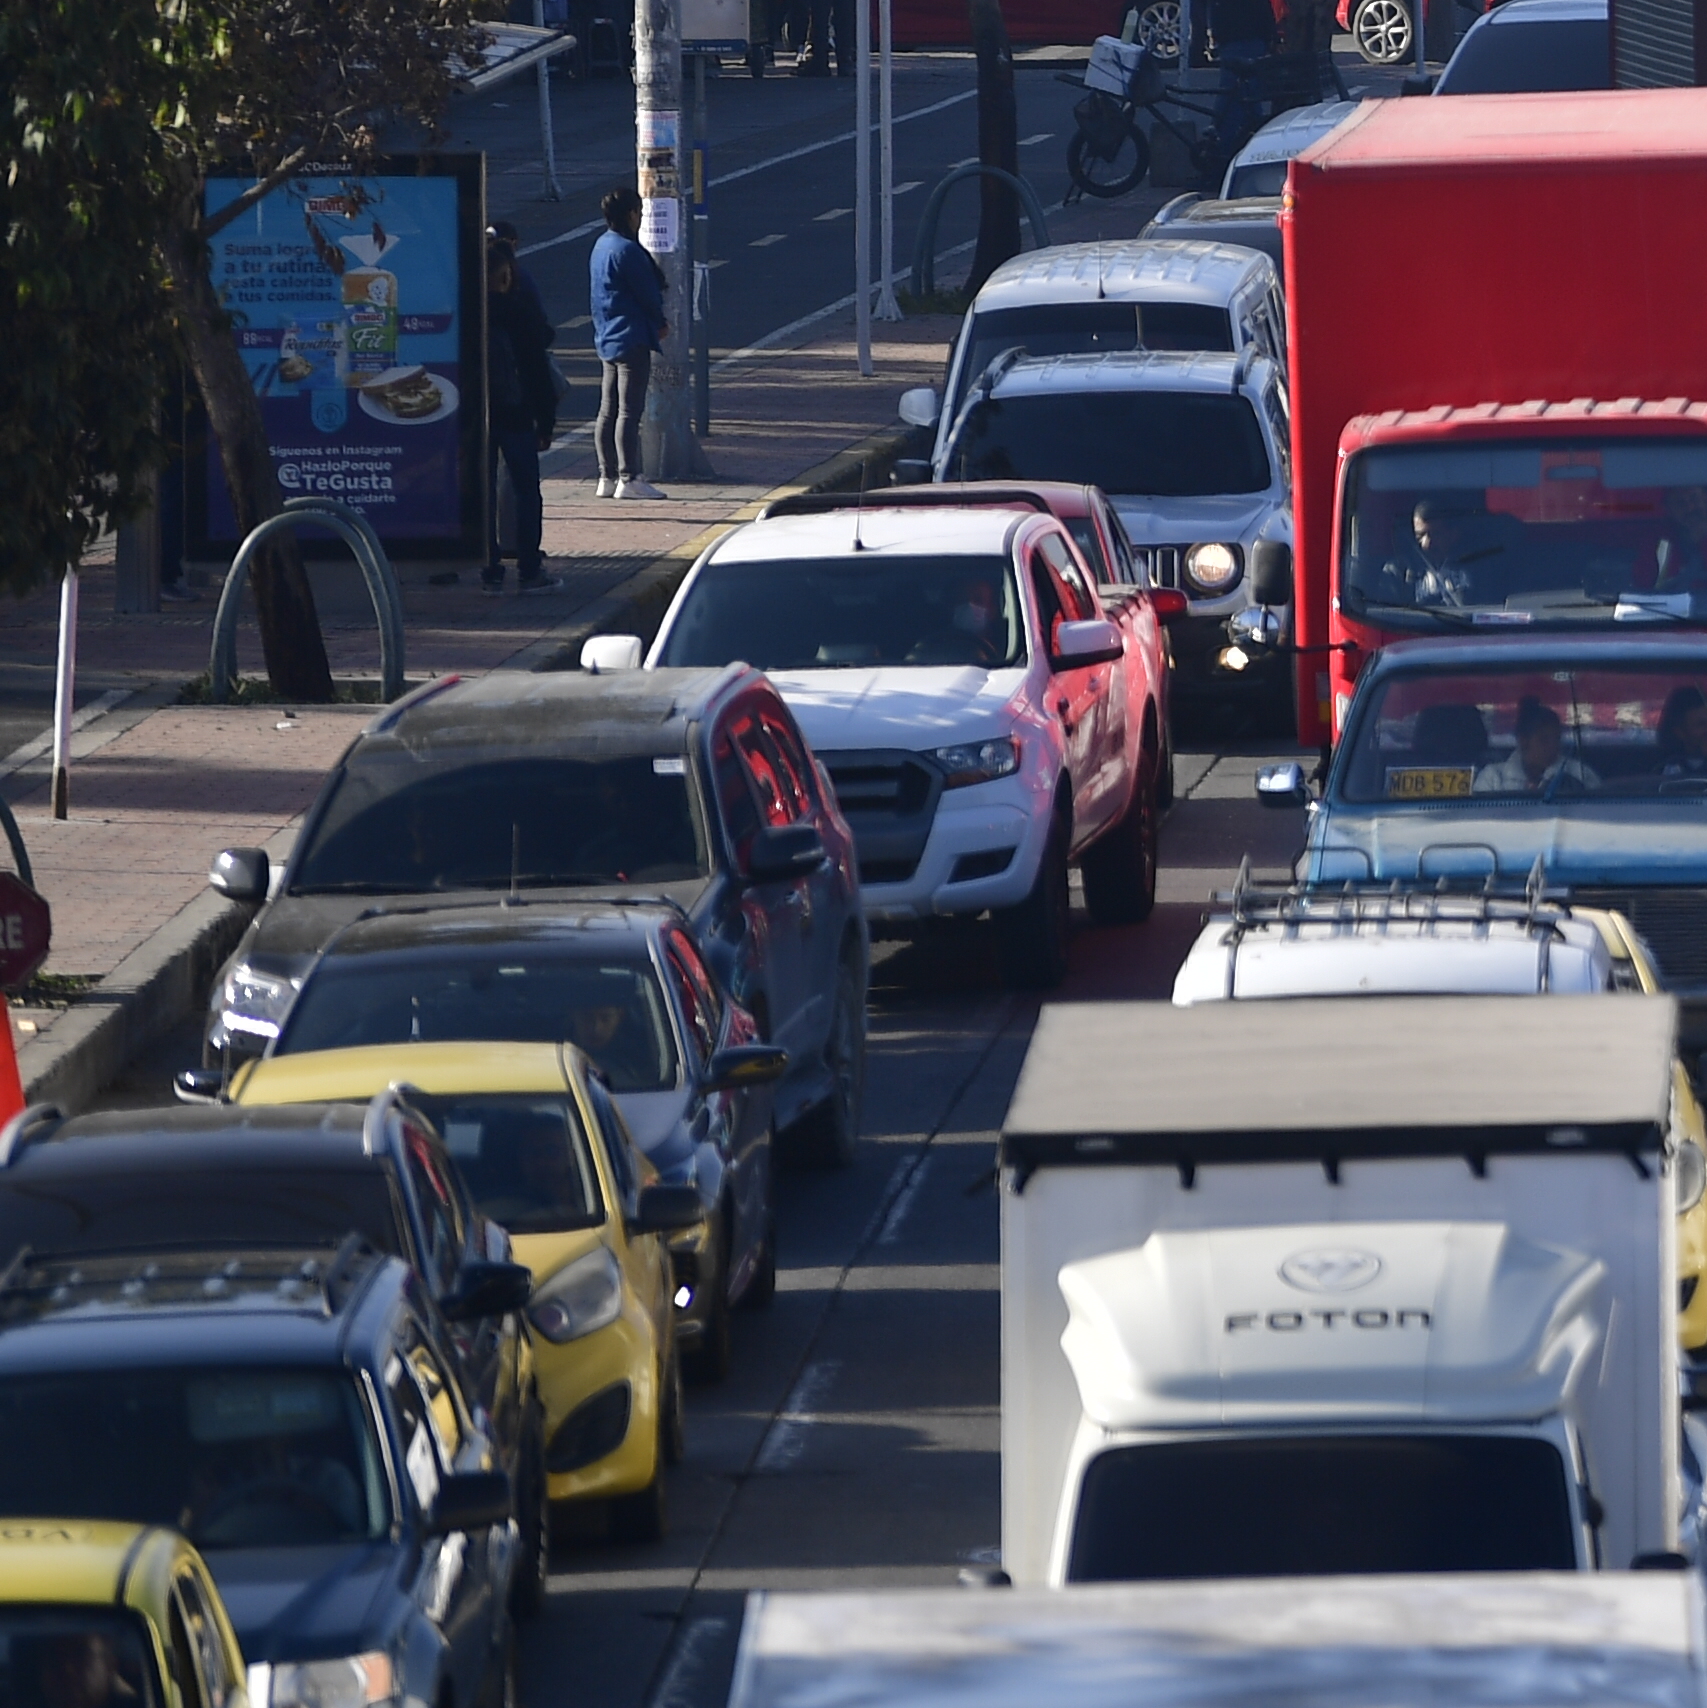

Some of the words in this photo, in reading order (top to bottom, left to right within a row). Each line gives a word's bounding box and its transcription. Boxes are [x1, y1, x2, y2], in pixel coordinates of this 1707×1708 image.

[224, 244, 272, 256] Suma
[224, 263, 236, 274] a
[241, 260, 262, 273] tu
[237, 290, 263, 302] tus
[267, 289, 337, 302] comidas.
[325, 447, 340, 455] en
[342, 445, 402, 456] Instagram
[301, 460, 392, 472] HazloPorque
[302, 473, 392, 491] TeGusta
[347, 493, 396, 503] cuidarte
[1226, 1307, 1430, 1332] FOTON
